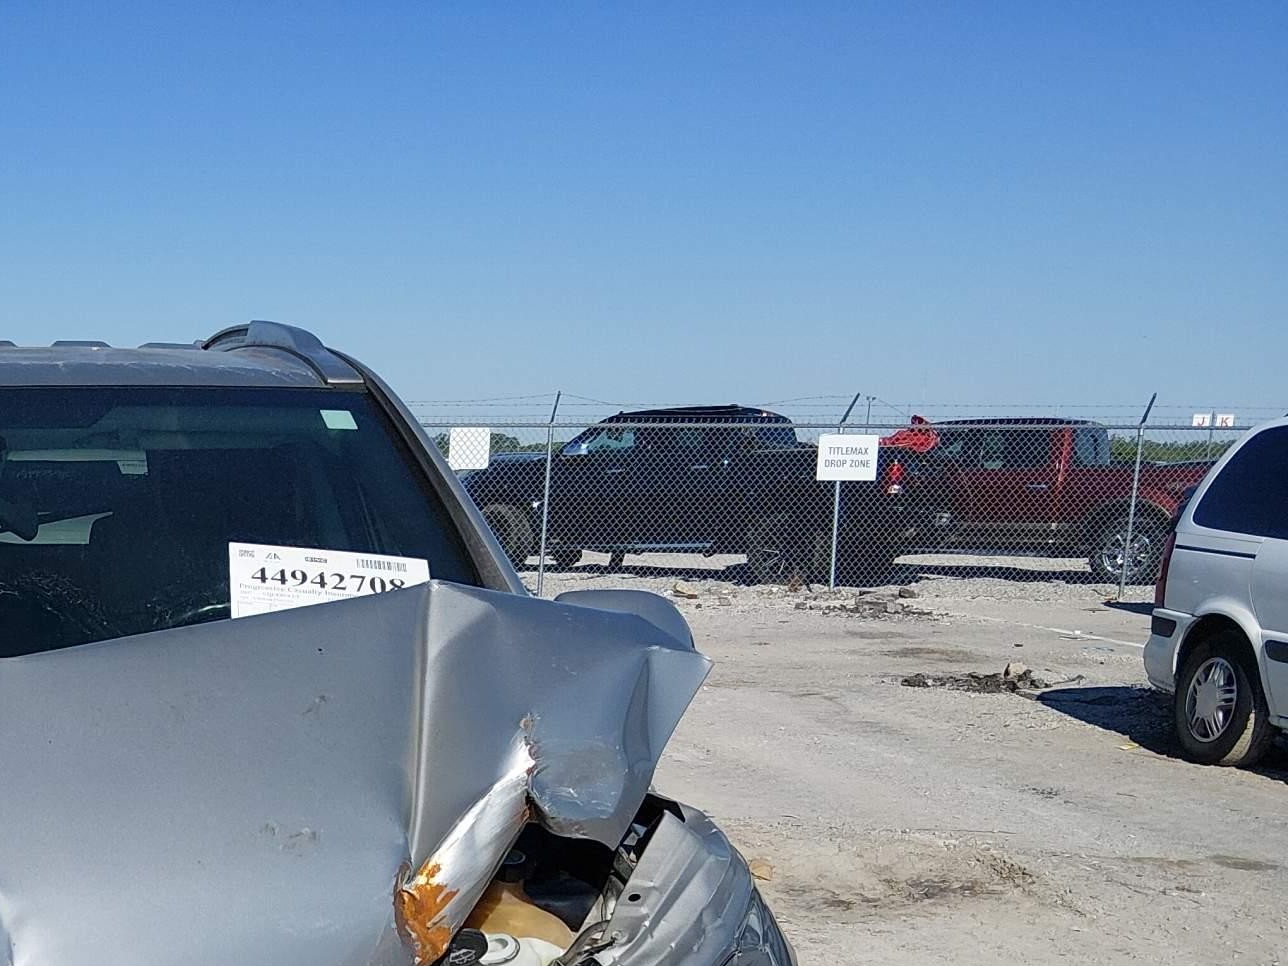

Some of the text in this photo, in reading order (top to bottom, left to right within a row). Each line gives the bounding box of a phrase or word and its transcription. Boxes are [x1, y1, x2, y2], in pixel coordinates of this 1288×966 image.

[1197, 416, 1205, 426] J
[1220, 416, 1230, 427] K
[827, 446, 870, 456] TITLEMAX
[824, 459, 871, 469] DROP ZONE
[251, 566, 405, 593] 44942708
